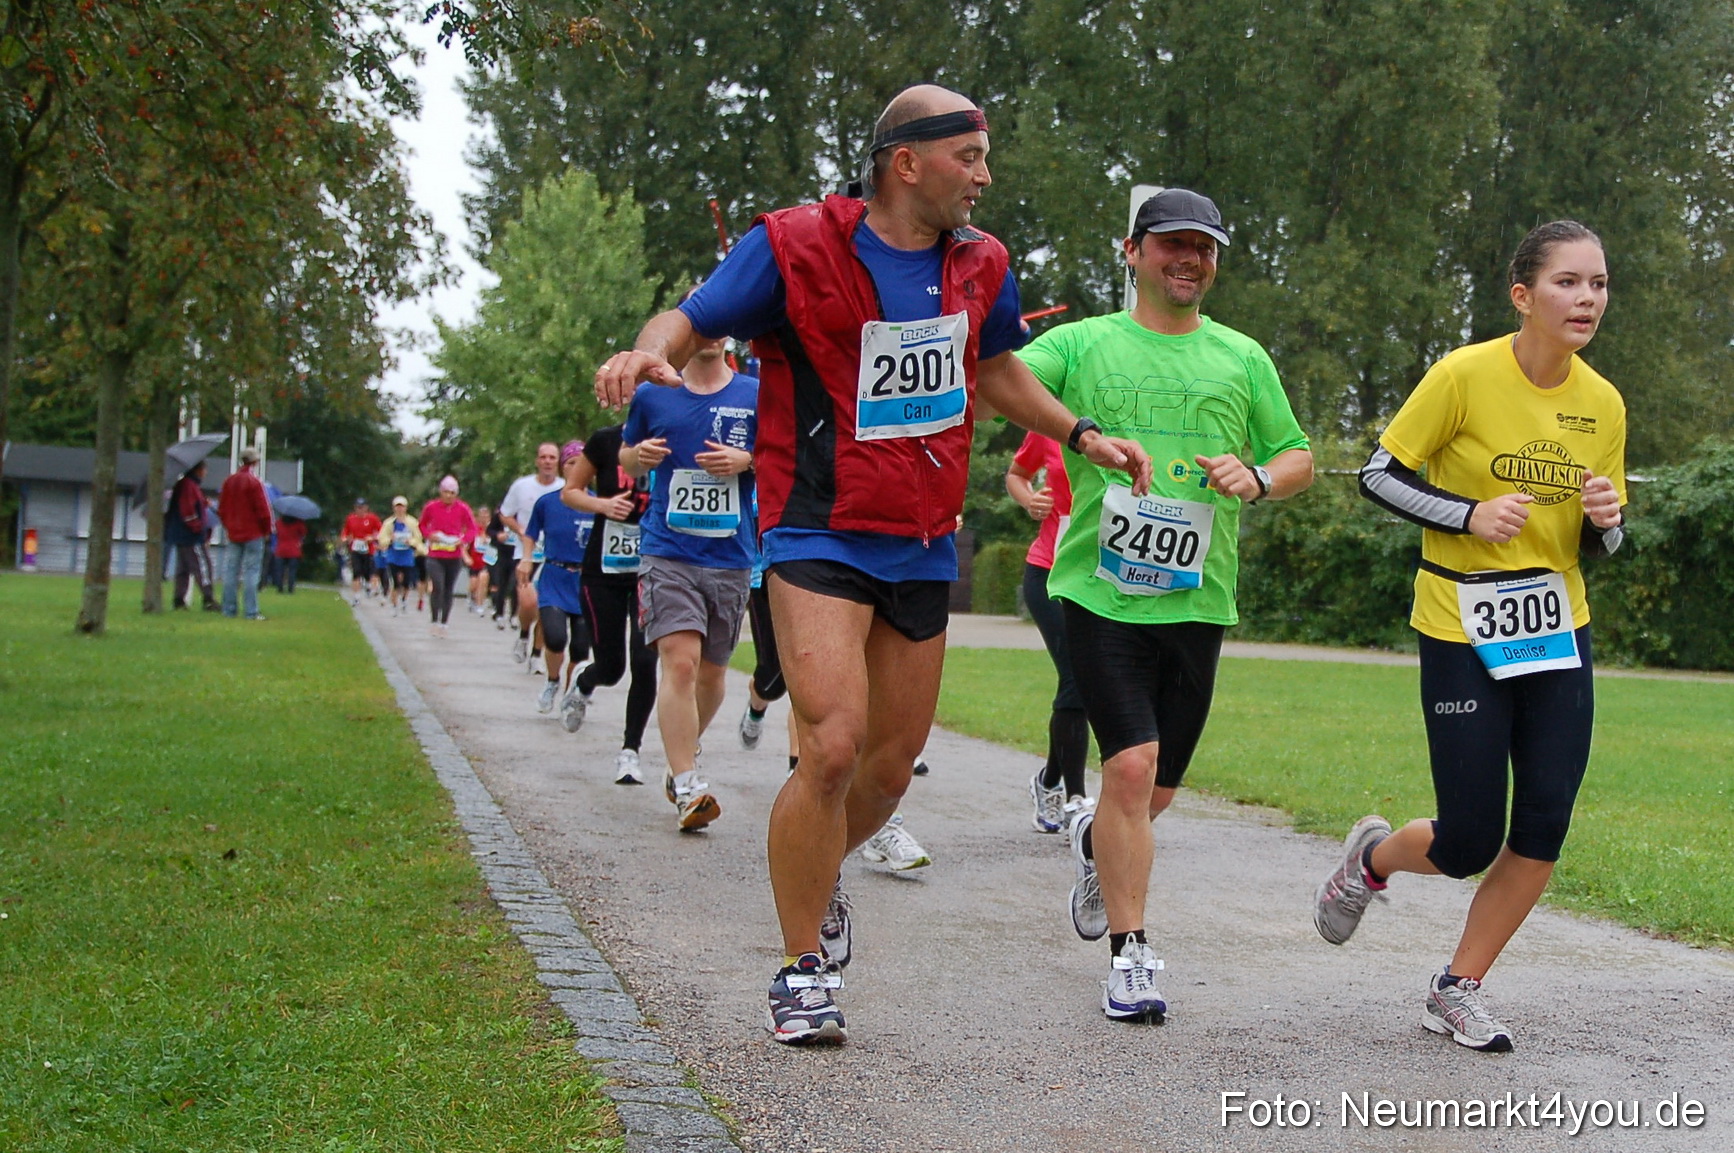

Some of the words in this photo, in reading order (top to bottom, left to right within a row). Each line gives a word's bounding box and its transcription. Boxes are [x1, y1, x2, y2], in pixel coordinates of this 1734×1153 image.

[926, 286, 942, 296] 12.
[901, 325, 939, 341] BOCK
[871, 344, 957, 397] 2901
[862, 391, 868, 399] D
[1093, 373, 1234, 430] OPF
[903, 403, 932, 420] Can
[1520, 442, 1573, 466] PIZZERIA
[1507, 458, 1582, 488] FRANCESCO
[676, 487, 731, 512] 2581
[1139, 500, 1183, 517] BOCK
[688, 517, 721, 528] Tobias
[1107, 515, 1200, 568] 2490
[1126, 567, 1161, 585] Horst
[1473, 590, 1561, 639] 3309
[1502, 644, 1547, 661] Denise
[1434, 699, 1478, 714] ODLO
